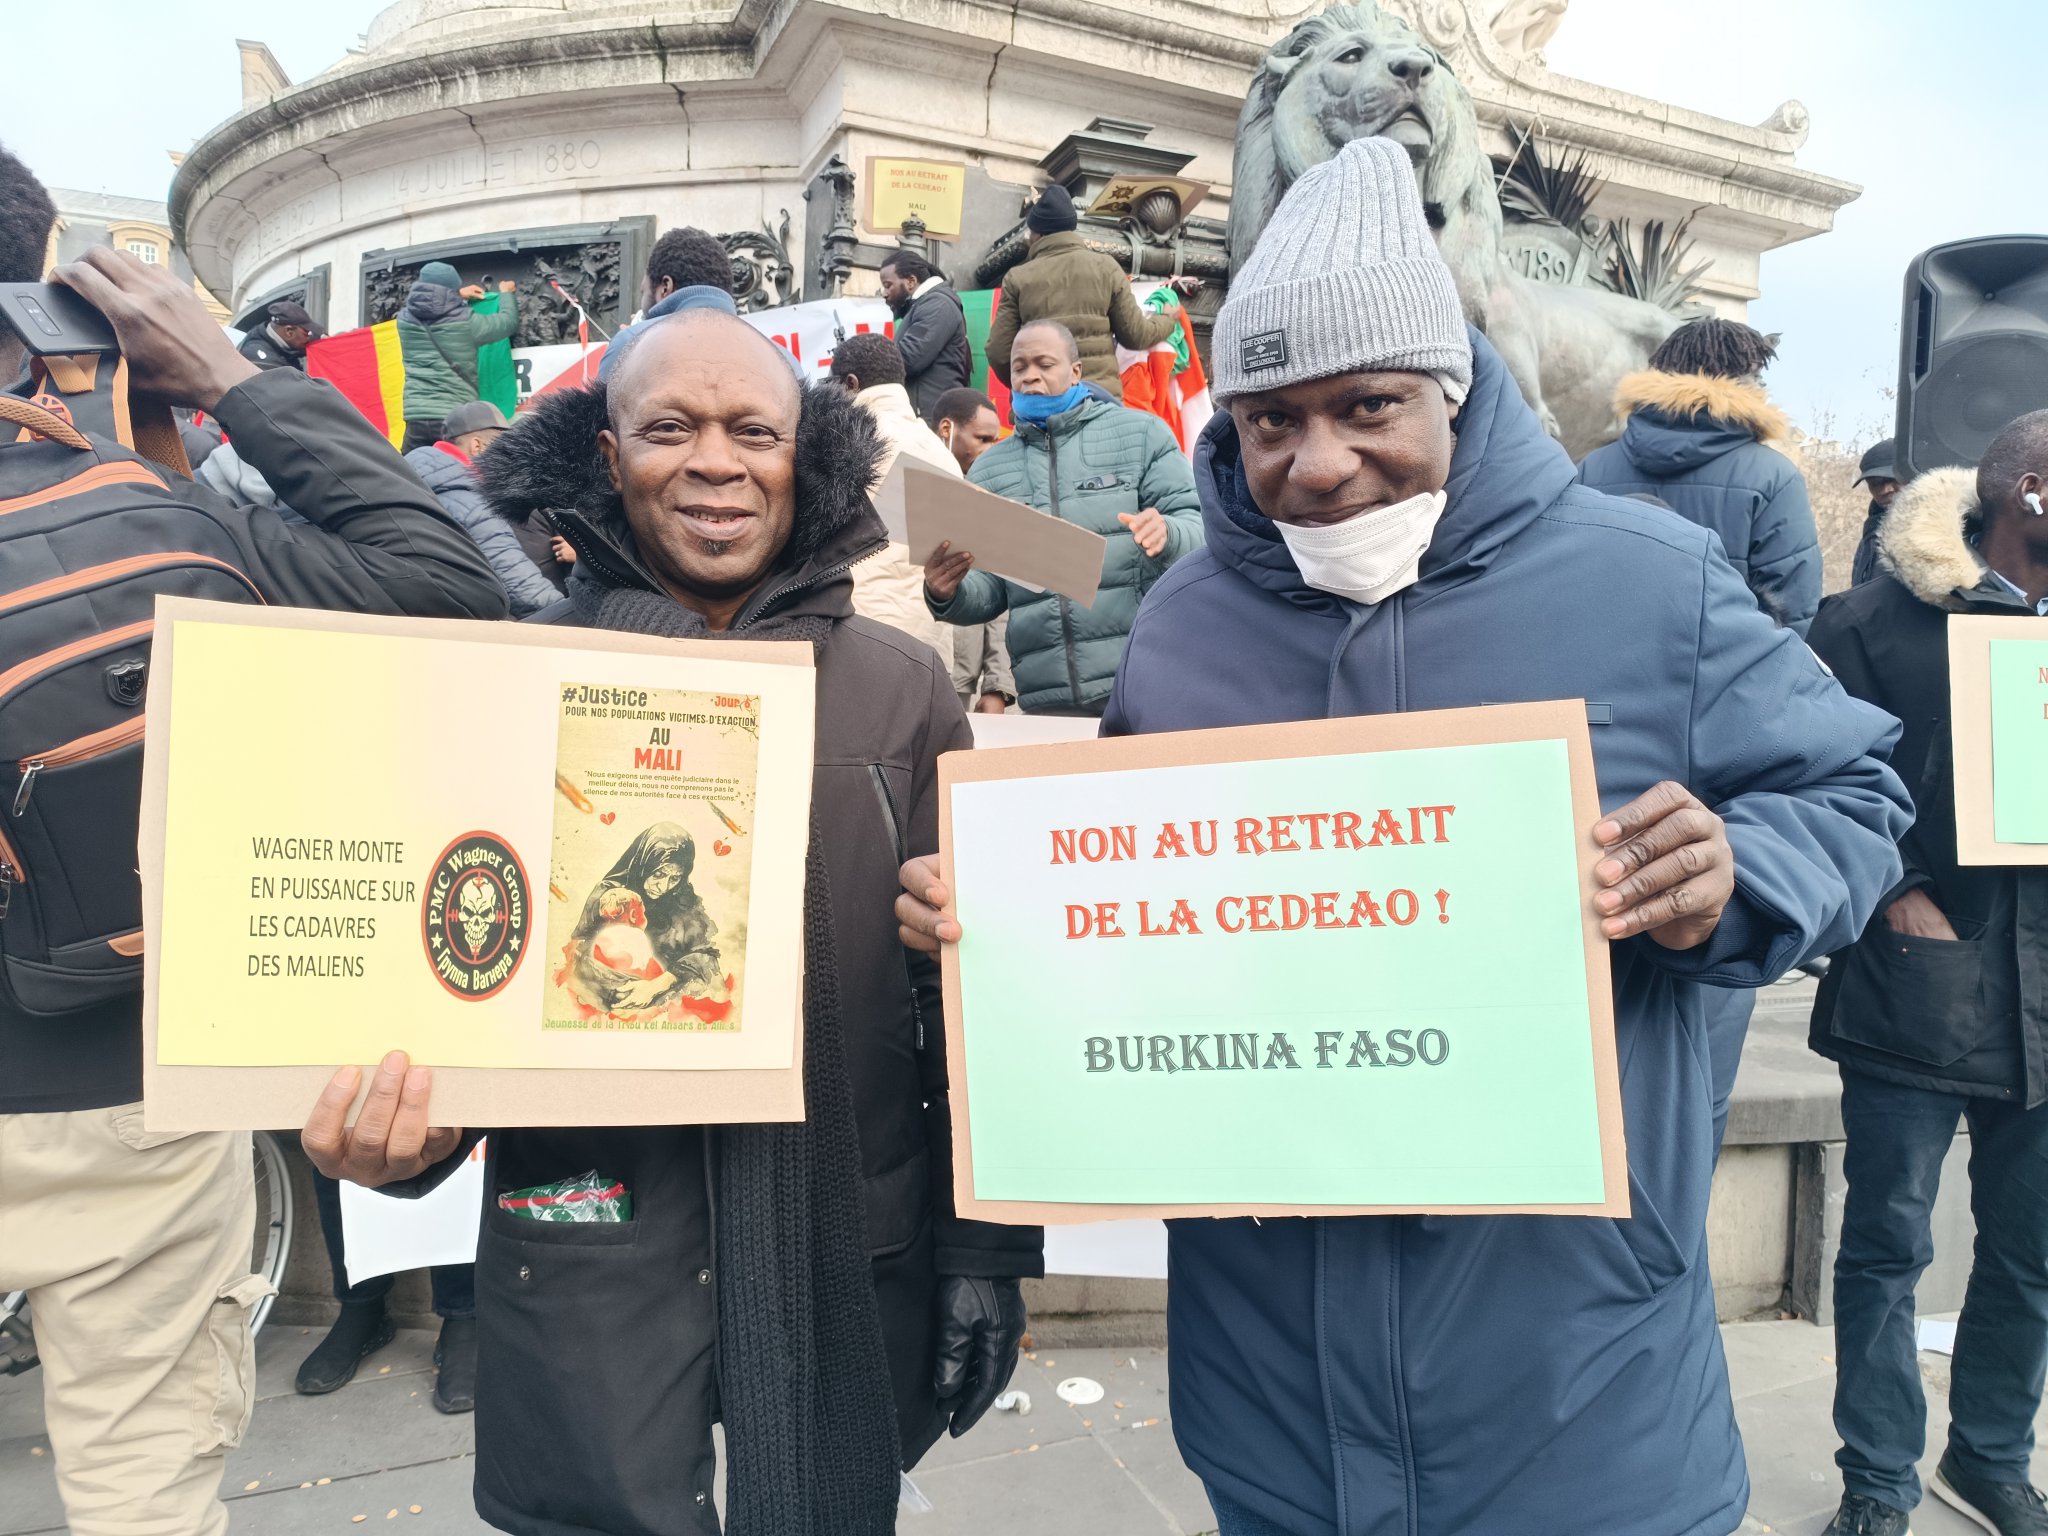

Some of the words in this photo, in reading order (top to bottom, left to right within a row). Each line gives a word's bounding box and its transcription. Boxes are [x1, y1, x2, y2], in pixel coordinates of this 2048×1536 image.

[418, 147, 524, 194] JUILLET
[536, 139, 601, 176] 1880
[917, 172, 949, 182] RETRAIT
[913, 183, 942, 193] CEDEAO
[1243, 340, 1254, 349] LEE
[1254, 335, 1280, 346] COOPER
[562, 685, 648, 707] #Justice
[714, 696, 740, 708] Jour
[565, 705, 587, 717] POUR
[590, 707, 608, 718] NOS
[611, 708, 666, 722] POPULATIONS
[669, 711, 706, 724] VICTIMES
[649, 727, 671, 746] AU
[634, 747, 682, 771] MALI
[607, 772, 638, 780] exigeons
[654, 774, 682, 782] enquête
[682, 775, 714, 783] judiciaire
[670, 784, 713, 792] comprenons
[583, 788, 608, 796] silence
[1050, 824, 1138, 865] NON
[1152, 818, 1220, 859] AU
[1234, 804, 1457, 856] RETRAIT
[252, 836, 334, 861] WAGNER
[339, 839, 404, 863] MONTE
[250, 876, 275, 899] EN
[281, 877, 377, 902] PUISSANCE
[382, 880, 416, 903] SUR
[429, 871, 451, 926] PMC
[447, 846, 503, 874] Wagner
[502, 864, 522, 929] Group
[1065, 901, 1126, 940] DE
[1136, 898, 1204, 937] LA
[1215, 888, 1420, 934] CEDEAO
[1434, 887, 1451, 925] !
[249, 915, 278, 938] LES
[284, 915, 376, 939] CADAVRES
[247, 954, 281, 977] DES
[286, 955, 365, 978] MALIENS
[437, 947, 469, 989] Группа
[472, 952, 513, 991] Вагнера
[545, 1019, 588, 1029] Jeunesse
[661, 1020, 694, 1030] Ansars
[1084, 1031, 1303, 1075] BURKINA
[1314, 1027, 1451, 1069] FASO
